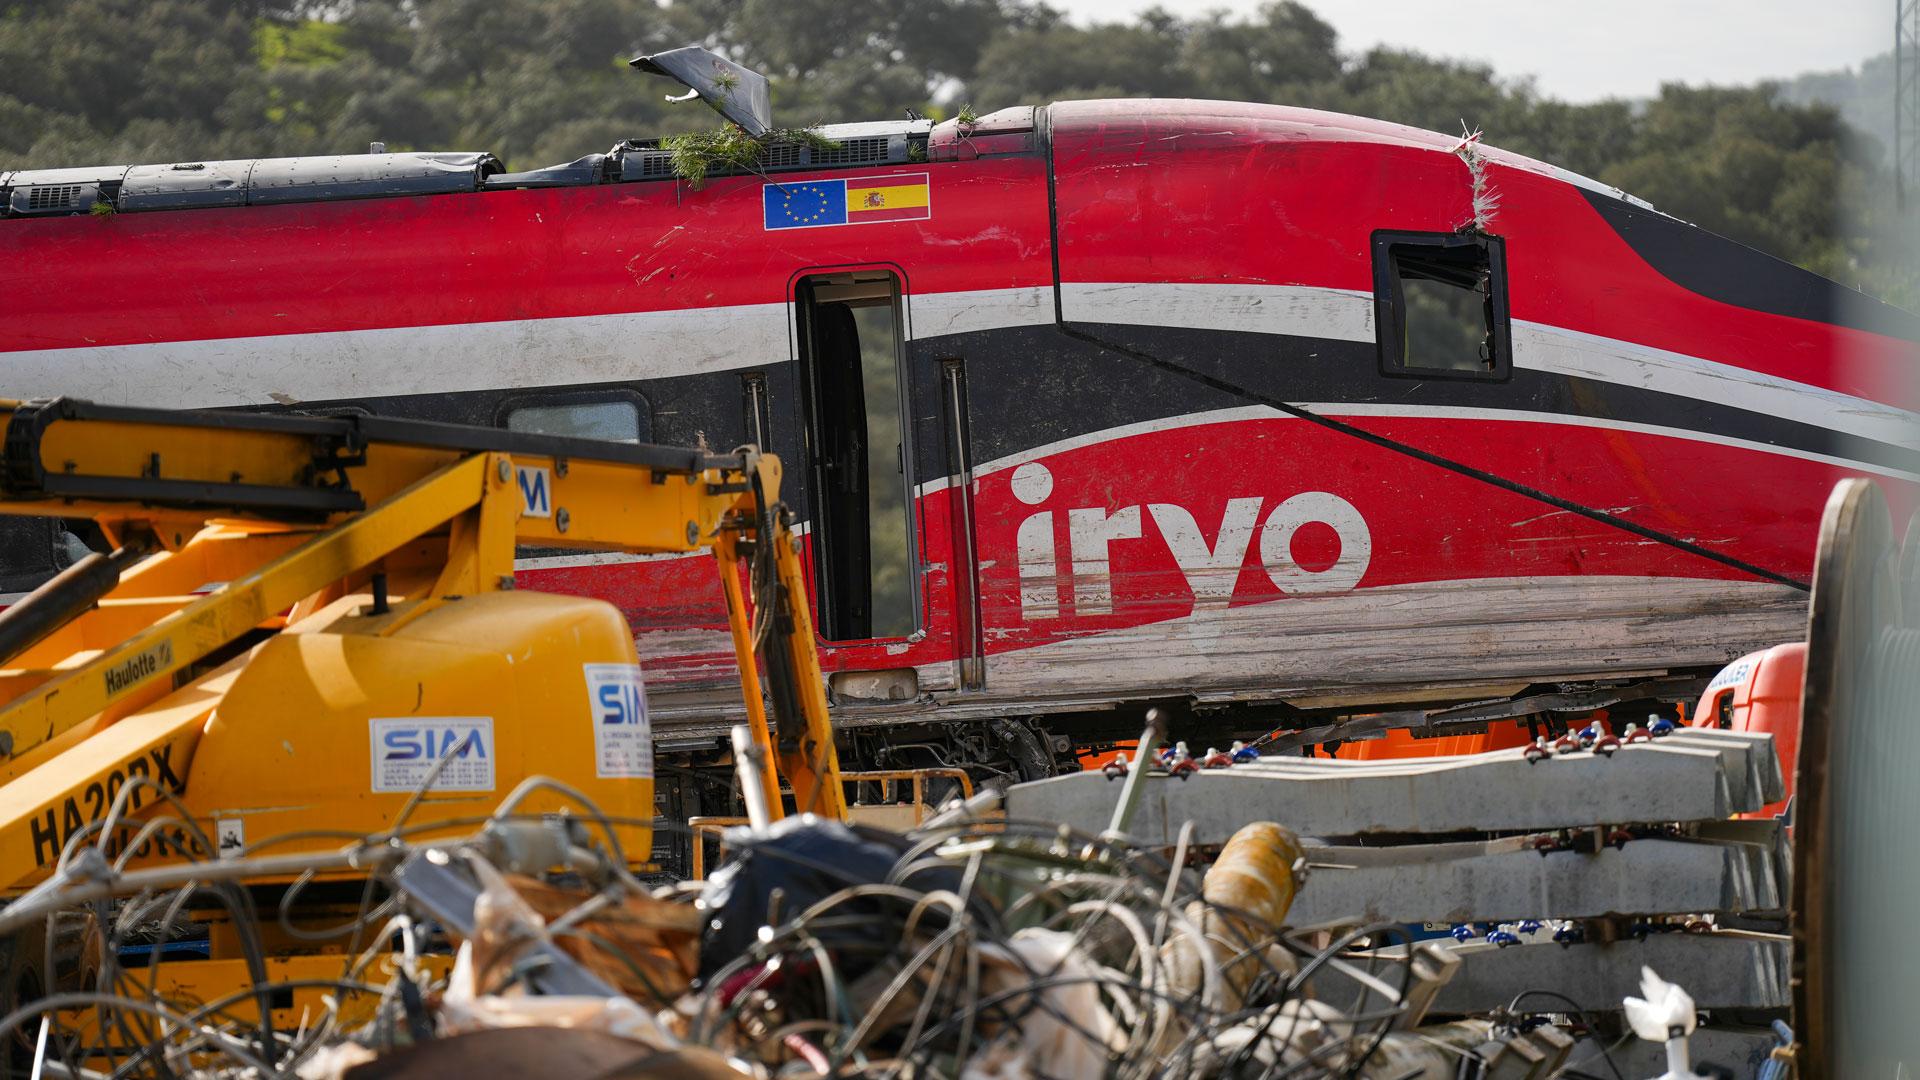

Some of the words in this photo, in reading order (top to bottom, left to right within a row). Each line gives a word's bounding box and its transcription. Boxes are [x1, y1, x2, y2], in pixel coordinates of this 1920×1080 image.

[1011, 462, 1371, 650] iryo
[105, 653, 156, 693] Haulotte
[384, 728, 486, 760] SIM
[30, 744, 182, 866] HA20PX
